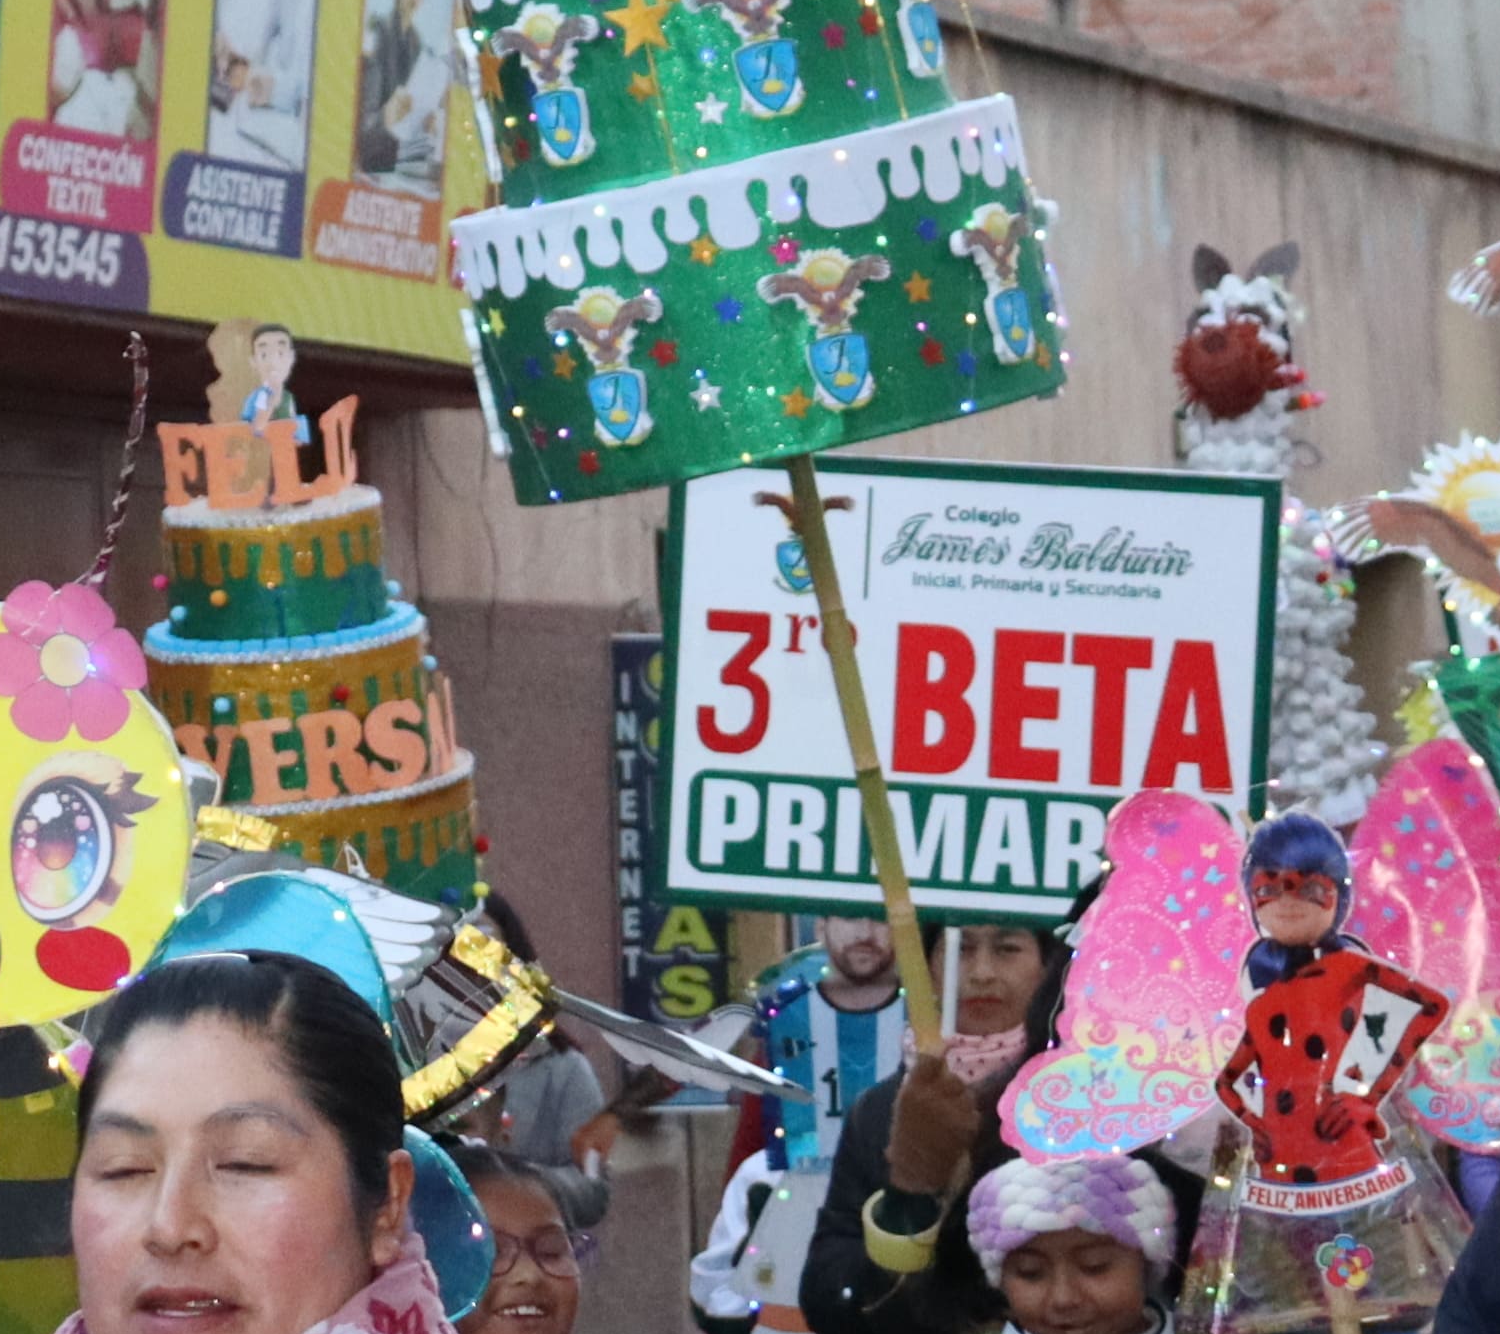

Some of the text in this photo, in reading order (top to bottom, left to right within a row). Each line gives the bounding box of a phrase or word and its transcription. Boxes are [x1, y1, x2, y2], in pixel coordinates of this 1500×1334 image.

[17, 132, 146, 185] CONFECCIÓN
[45, 176, 107, 221] TEXTIL
[186, 161, 288, 213] ASISTENTE
[182, 206, 281, 251] CONTABLE
[944, 505, 1021, 527] Colegio
[881, 513, 1195, 577] James Baldwin
[912, 571, 1162, 600] Inicial, Primaria y Secundaria
[890, 621, 1235, 794] BETA
[615, 670, 645, 980] INTERNET
[1246, 1164, 1408, 1211] FELIZ ANIVERSARIO
